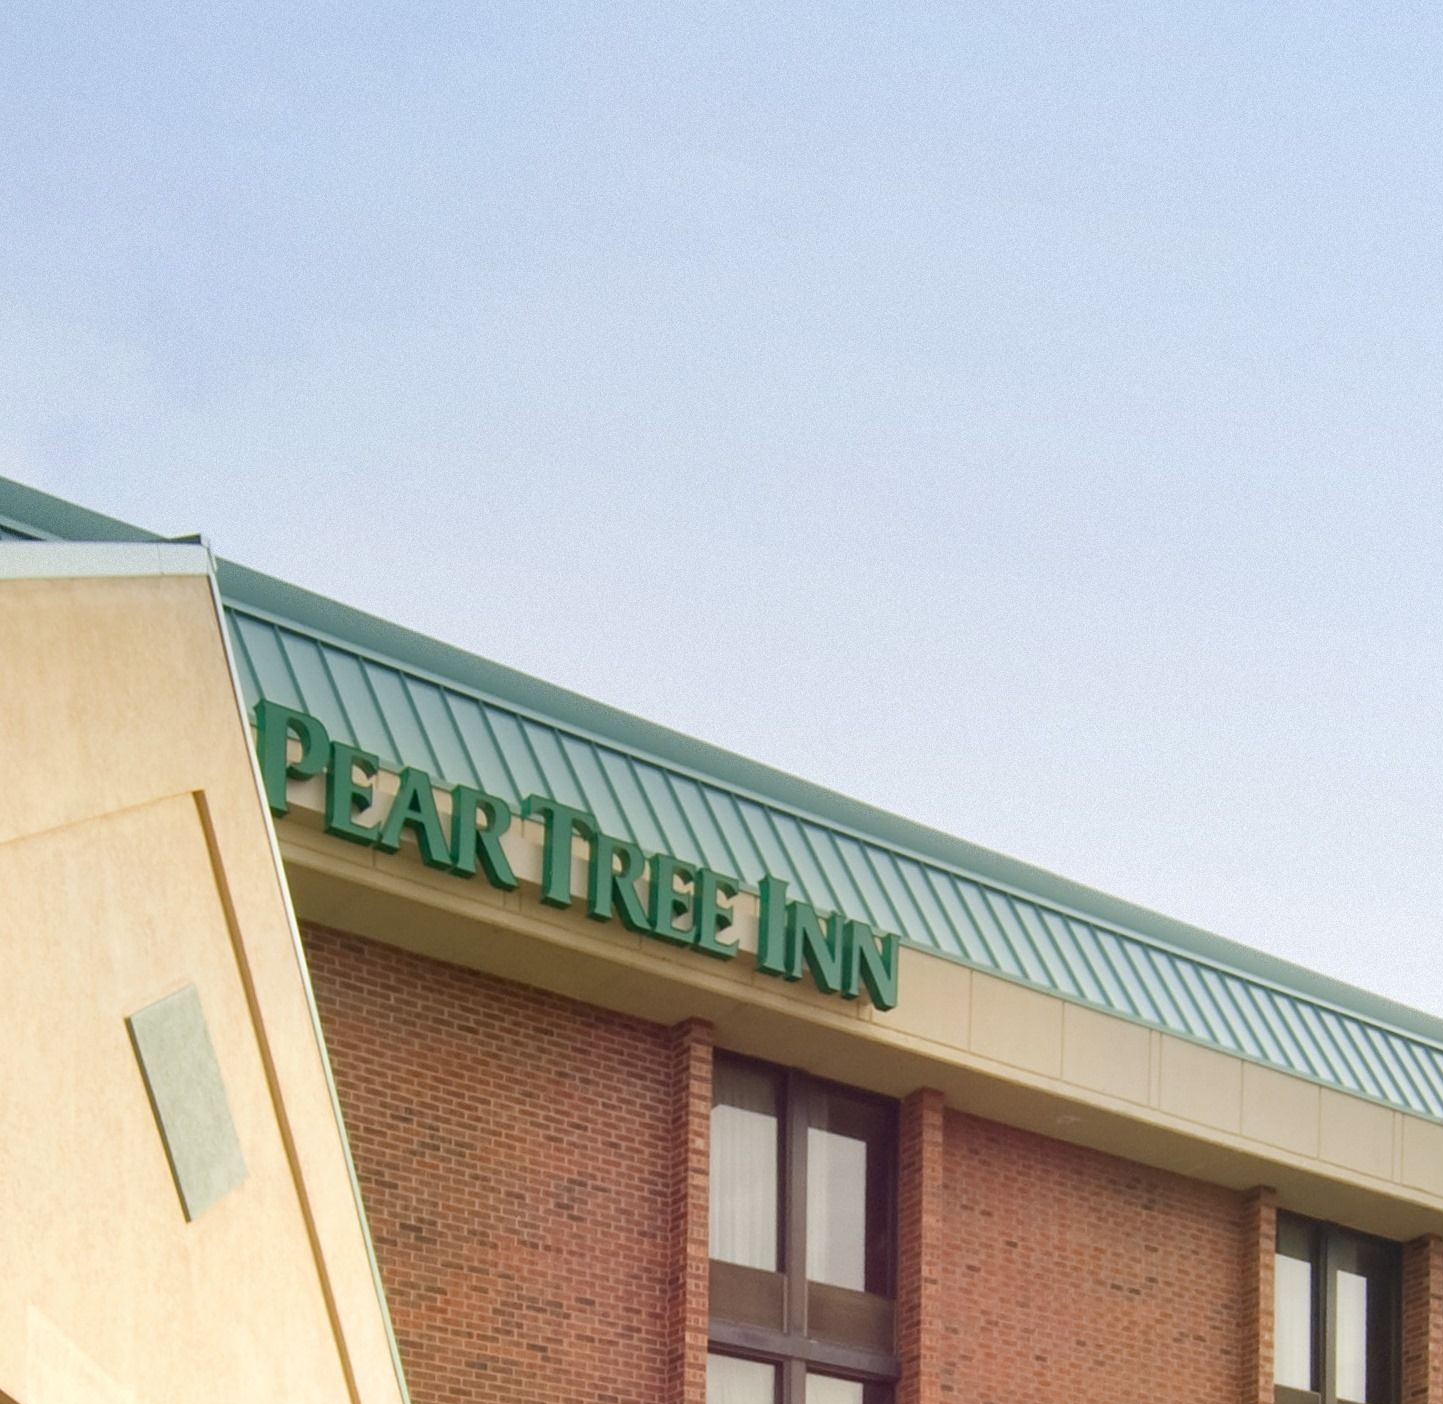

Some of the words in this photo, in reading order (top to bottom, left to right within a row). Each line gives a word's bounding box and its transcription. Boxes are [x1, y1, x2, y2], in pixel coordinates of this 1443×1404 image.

[254, 699, 519, 891] PEAR
[521, 793, 740, 960] TREE
[756, 873, 900, 1011] INN
